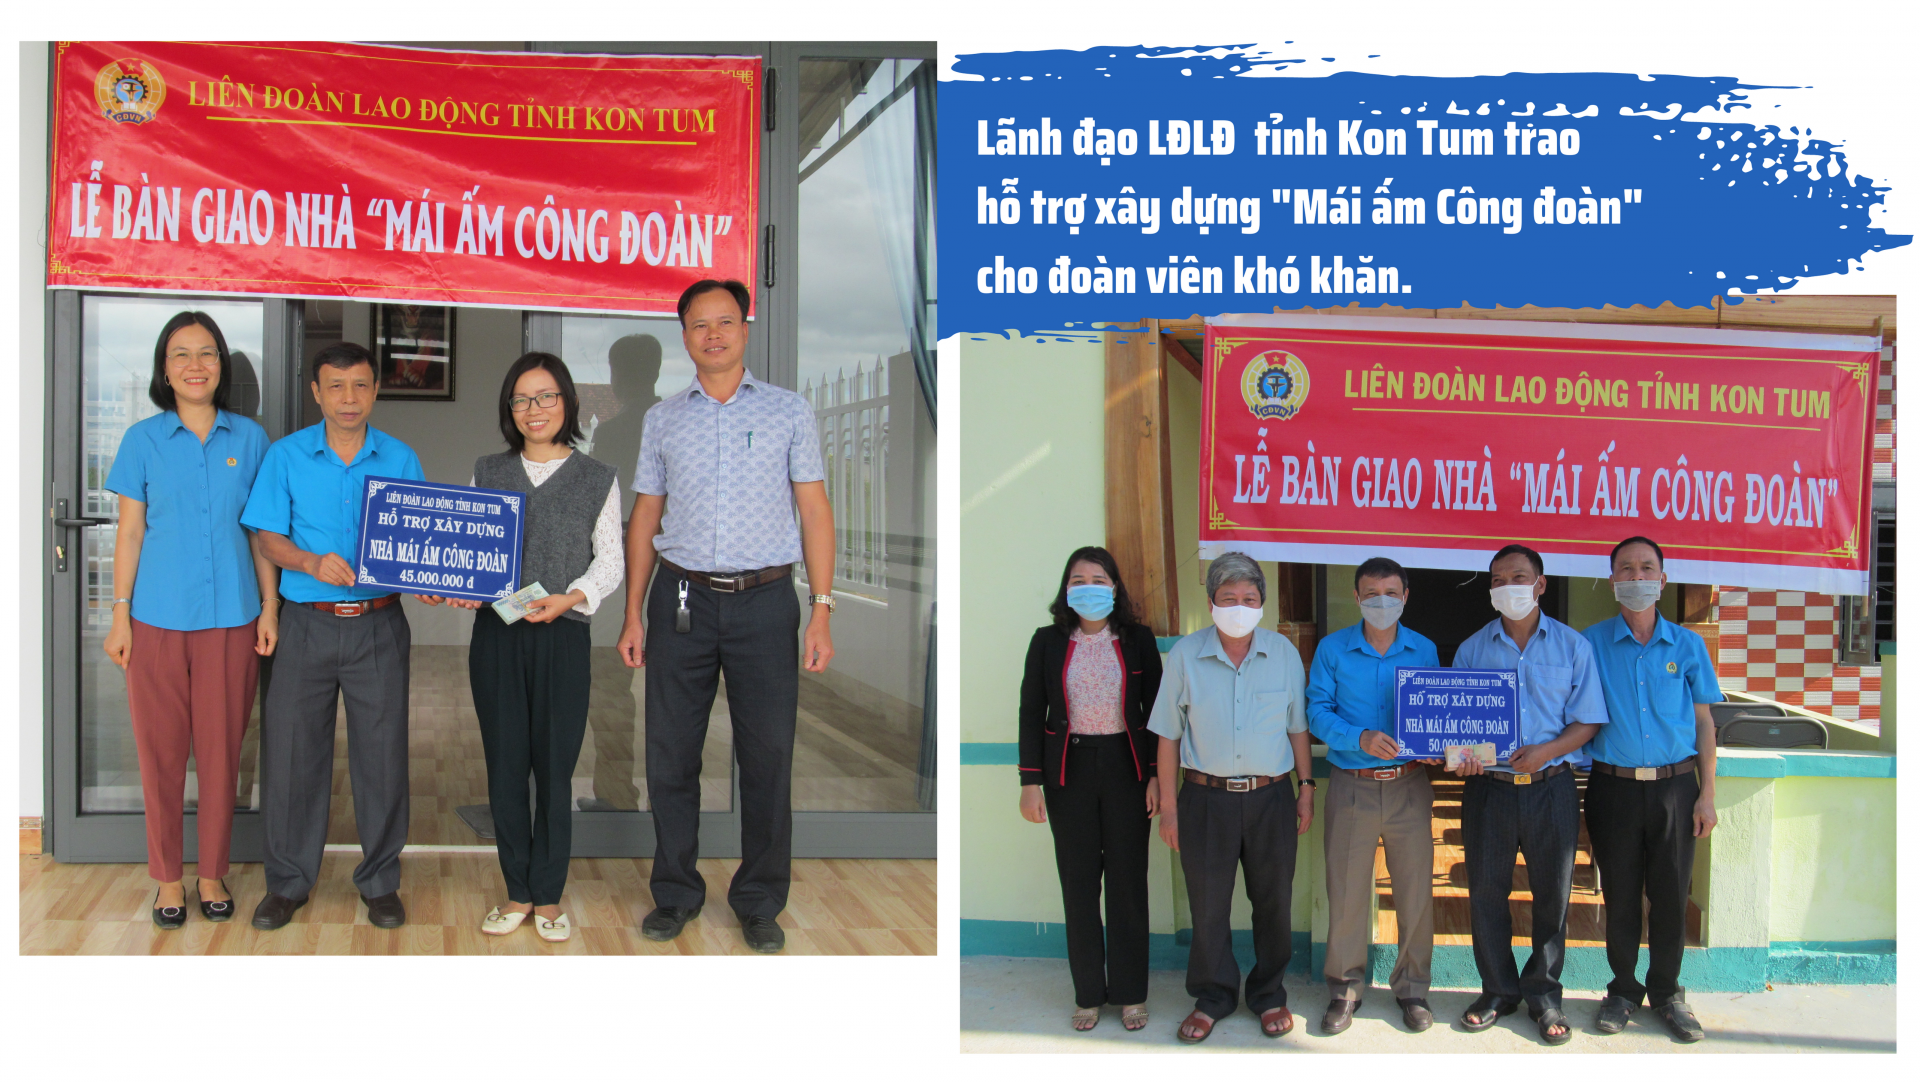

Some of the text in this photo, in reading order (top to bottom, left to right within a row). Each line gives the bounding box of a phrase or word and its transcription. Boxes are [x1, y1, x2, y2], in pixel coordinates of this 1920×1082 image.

[188, 75, 716, 133] LIÊN ĐOÀN LAO ĐỘNG TỈNH KON TUM
[70, 160, 732, 268] LỄ BÀN GIAO NHÀ “MÁI ẤM CÔNG ĐOÀN”
[1344, 363, 1830, 419] LIÊN ĐOÀN LAO ĐỘNG TỈNH KON TUM
[1233, 427, 1838, 528] LỄ BÀN GIAO NHÀ “MÁI ẤM CÔNG ĐOÀN”
[386, 490, 501, 515] LIÊN ĐOÀN LAO ĐỘNG TỈNH KON TUM
[378, 508, 504, 538] HỖ TRỢ XÂY DỰNG
[369, 536, 508, 573] NHÀ MÁI ẤM CÔNG ĐOÀN
[400, 569, 474, 588] 45.000.000 đ
[1426, 676, 1439, 685] ĐOÀN
[1440, 678, 1450, 686] LAO
[1427, 693, 1448, 708] TRỢ
[1452, 692, 1473, 706] XÂY
[1476, 694, 1505, 709] DỰNG
[1405, 712, 1509, 734] NHÀ MÁI ẤM CÔNG ĐOÀN
